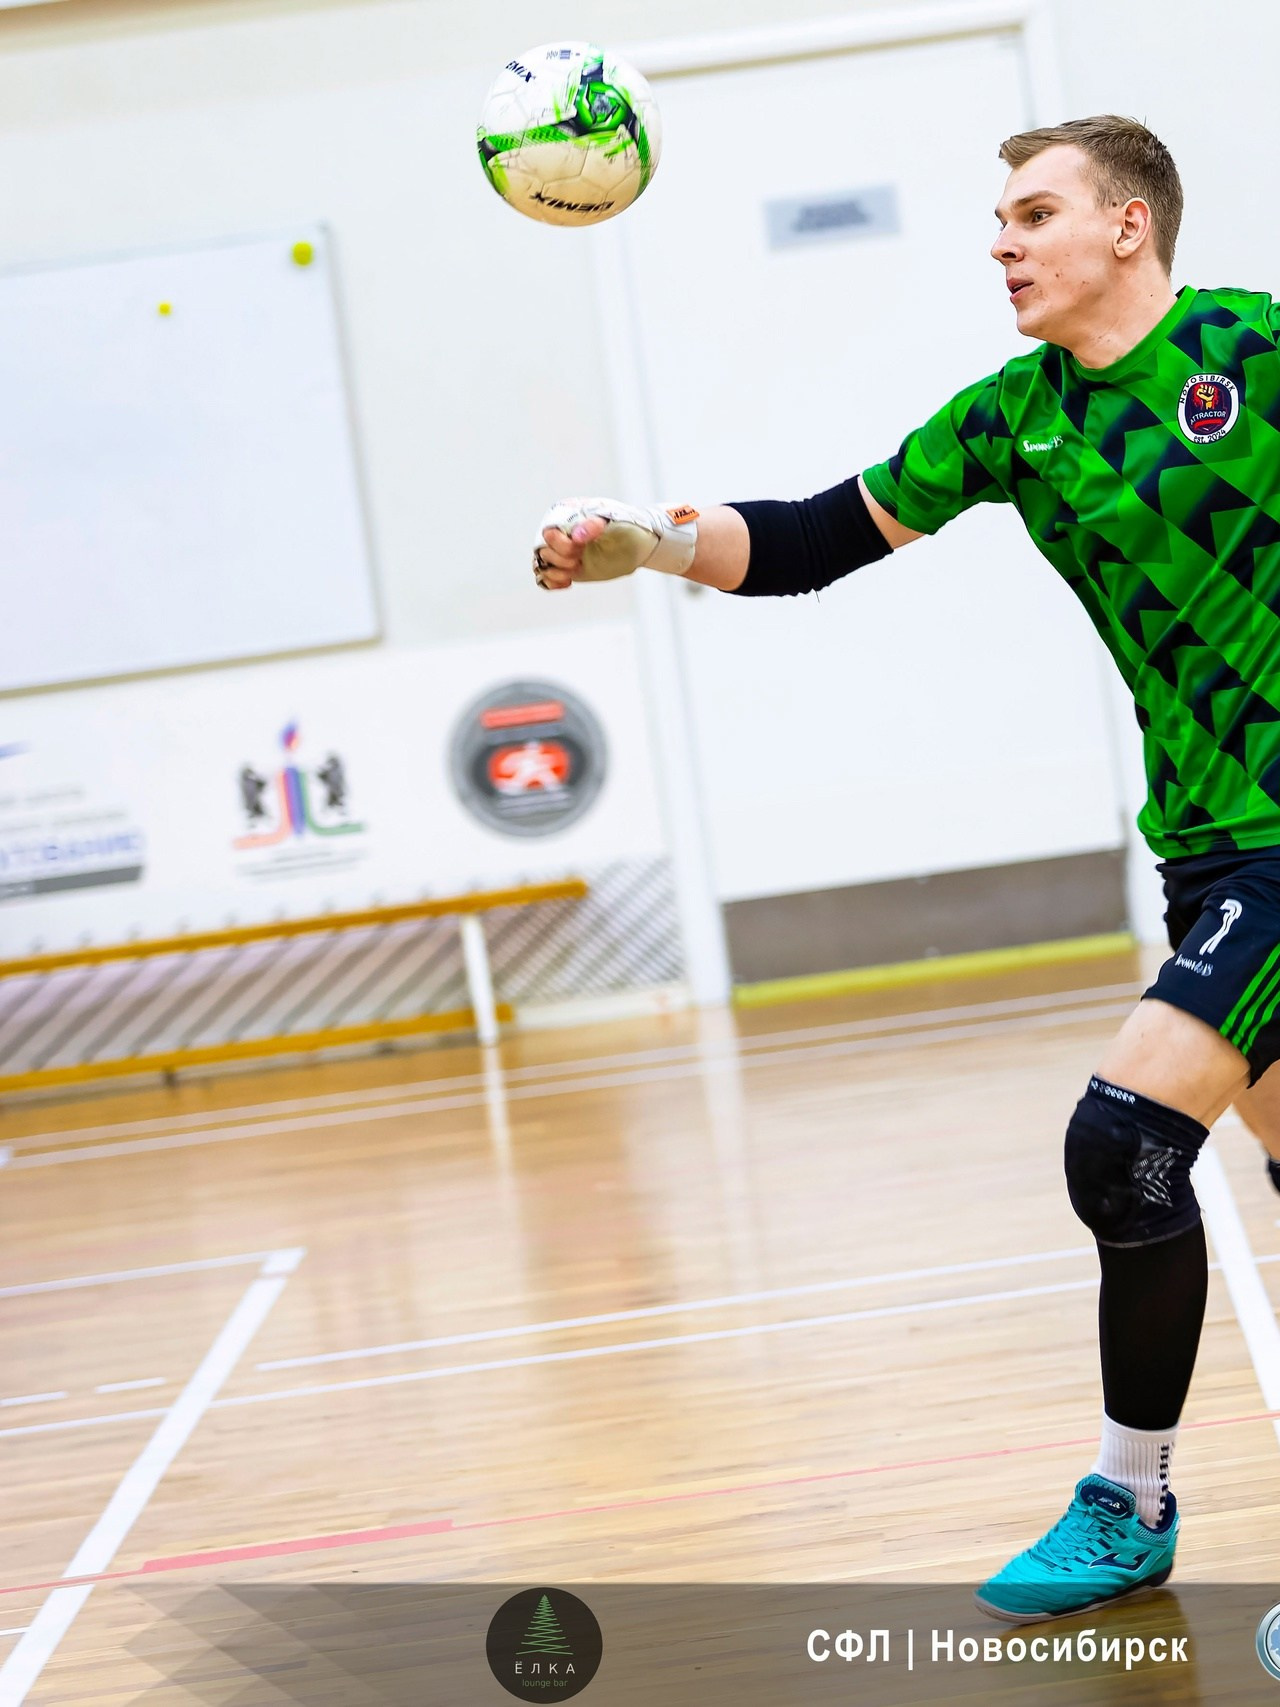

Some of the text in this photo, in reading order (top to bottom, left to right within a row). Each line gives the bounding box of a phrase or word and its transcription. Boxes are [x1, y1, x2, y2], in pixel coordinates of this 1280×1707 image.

[503, 59, 536, 83] EMIX
[529, 191, 615, 213] DEMIX
[1179, 375, 1236, 404] NOVOSIBIRSK
[1190, 410, 1227, 425] ATTRACTOR
[1208, 429, 1226, 443] 2024
